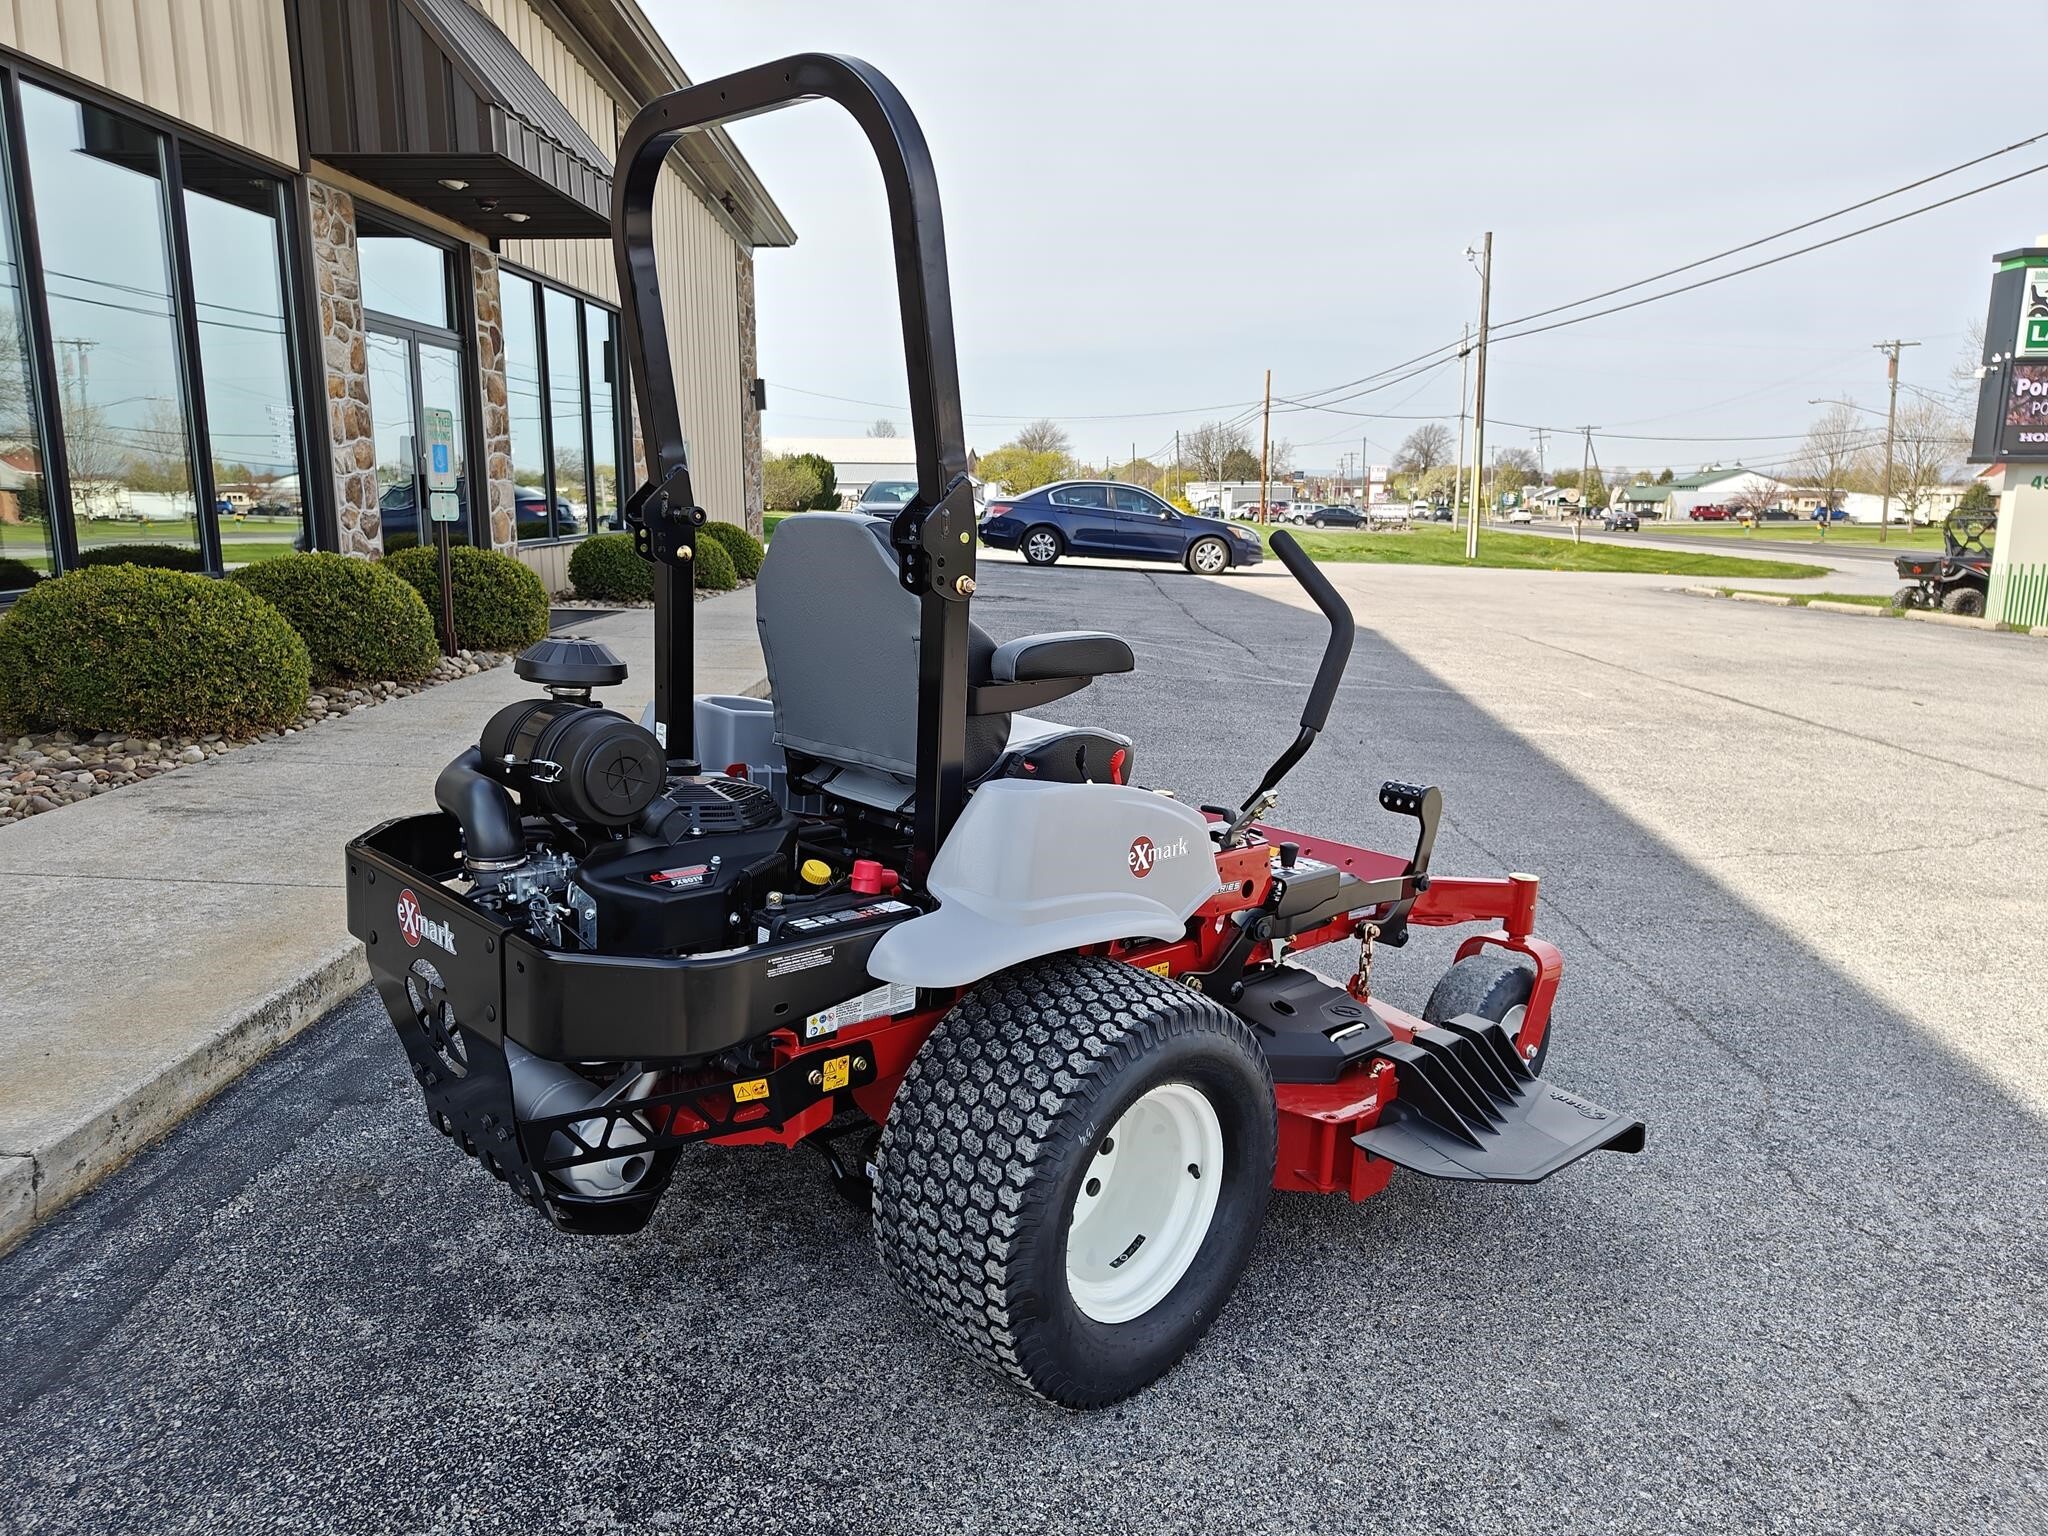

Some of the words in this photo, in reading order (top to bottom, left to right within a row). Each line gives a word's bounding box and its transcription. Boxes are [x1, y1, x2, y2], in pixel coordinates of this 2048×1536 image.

[2019, 432, 2048, 442] HO
[670, 875, 703, 886] FX801V
[1217, 881, 1241, 893] RIES
[397, 895, 458, 956] eXmark
